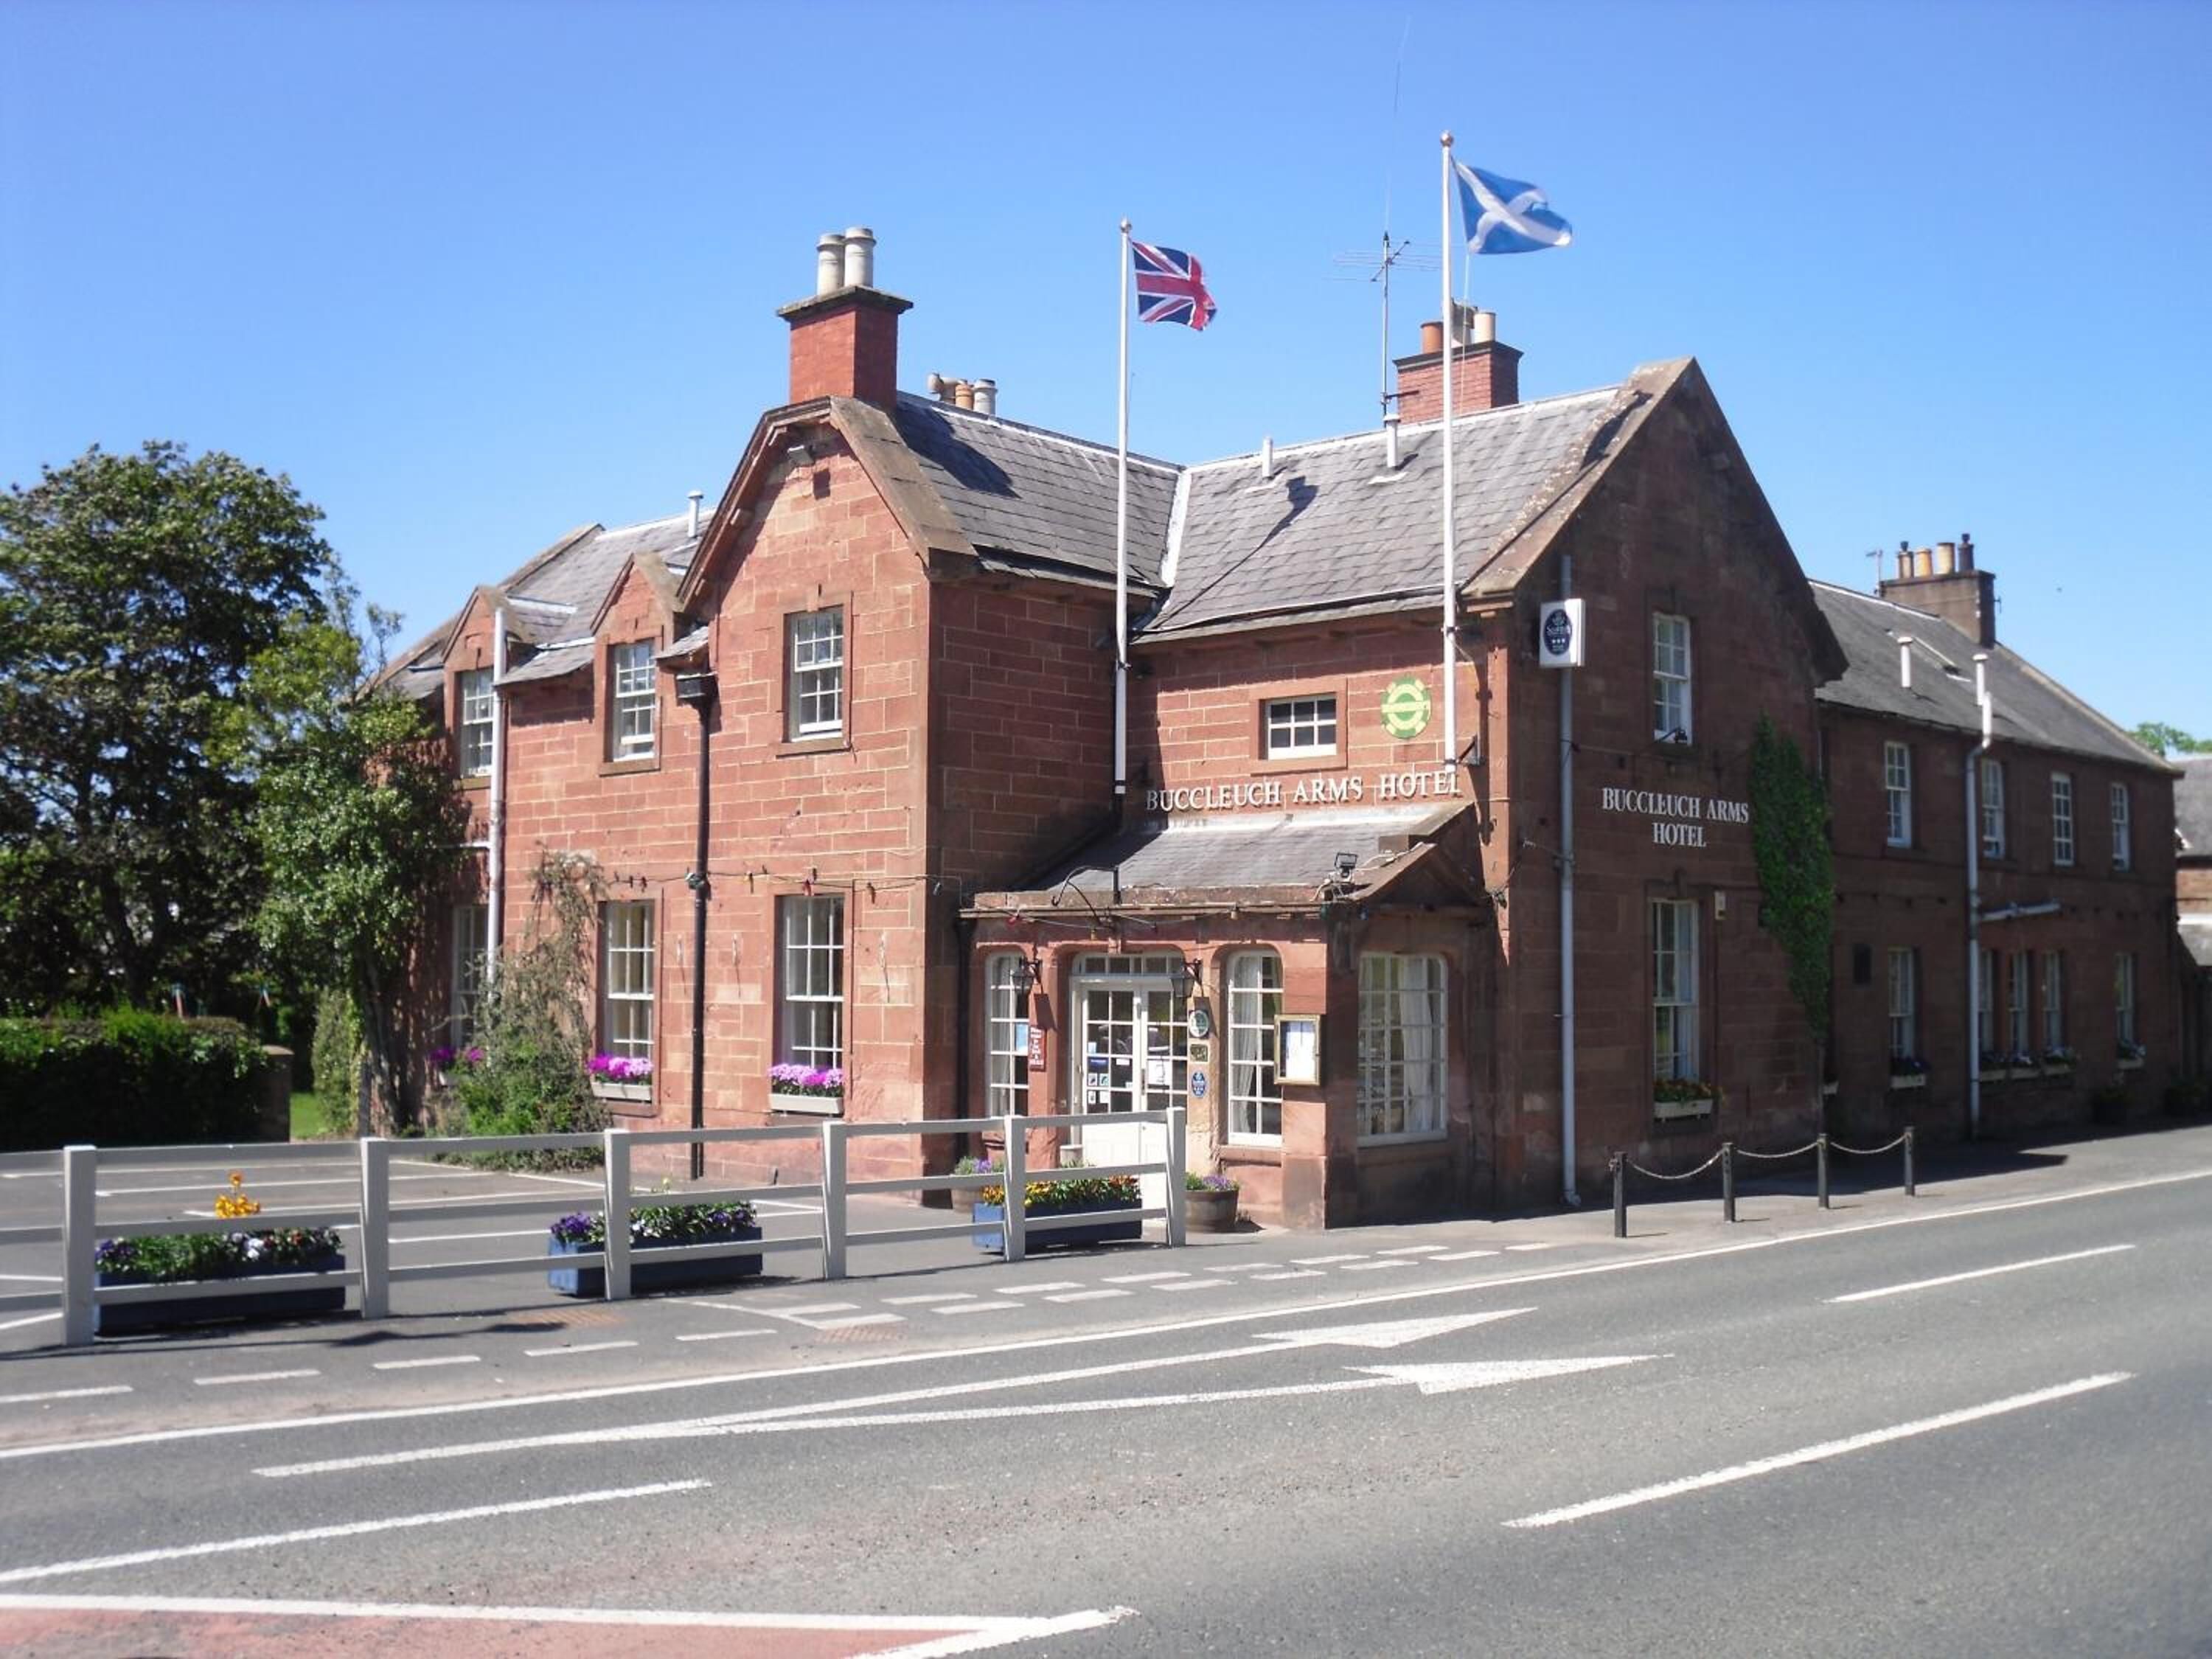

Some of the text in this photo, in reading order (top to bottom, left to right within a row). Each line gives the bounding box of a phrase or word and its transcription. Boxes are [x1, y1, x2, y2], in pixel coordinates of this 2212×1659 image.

[1146, 770, 1463, 811] BUCCLEUCH ARMS HOTEL
[1602, 787, 1749, 824] BUCCLEUCH ARMS
[1652, 822, 1707, 848] HOTEL
